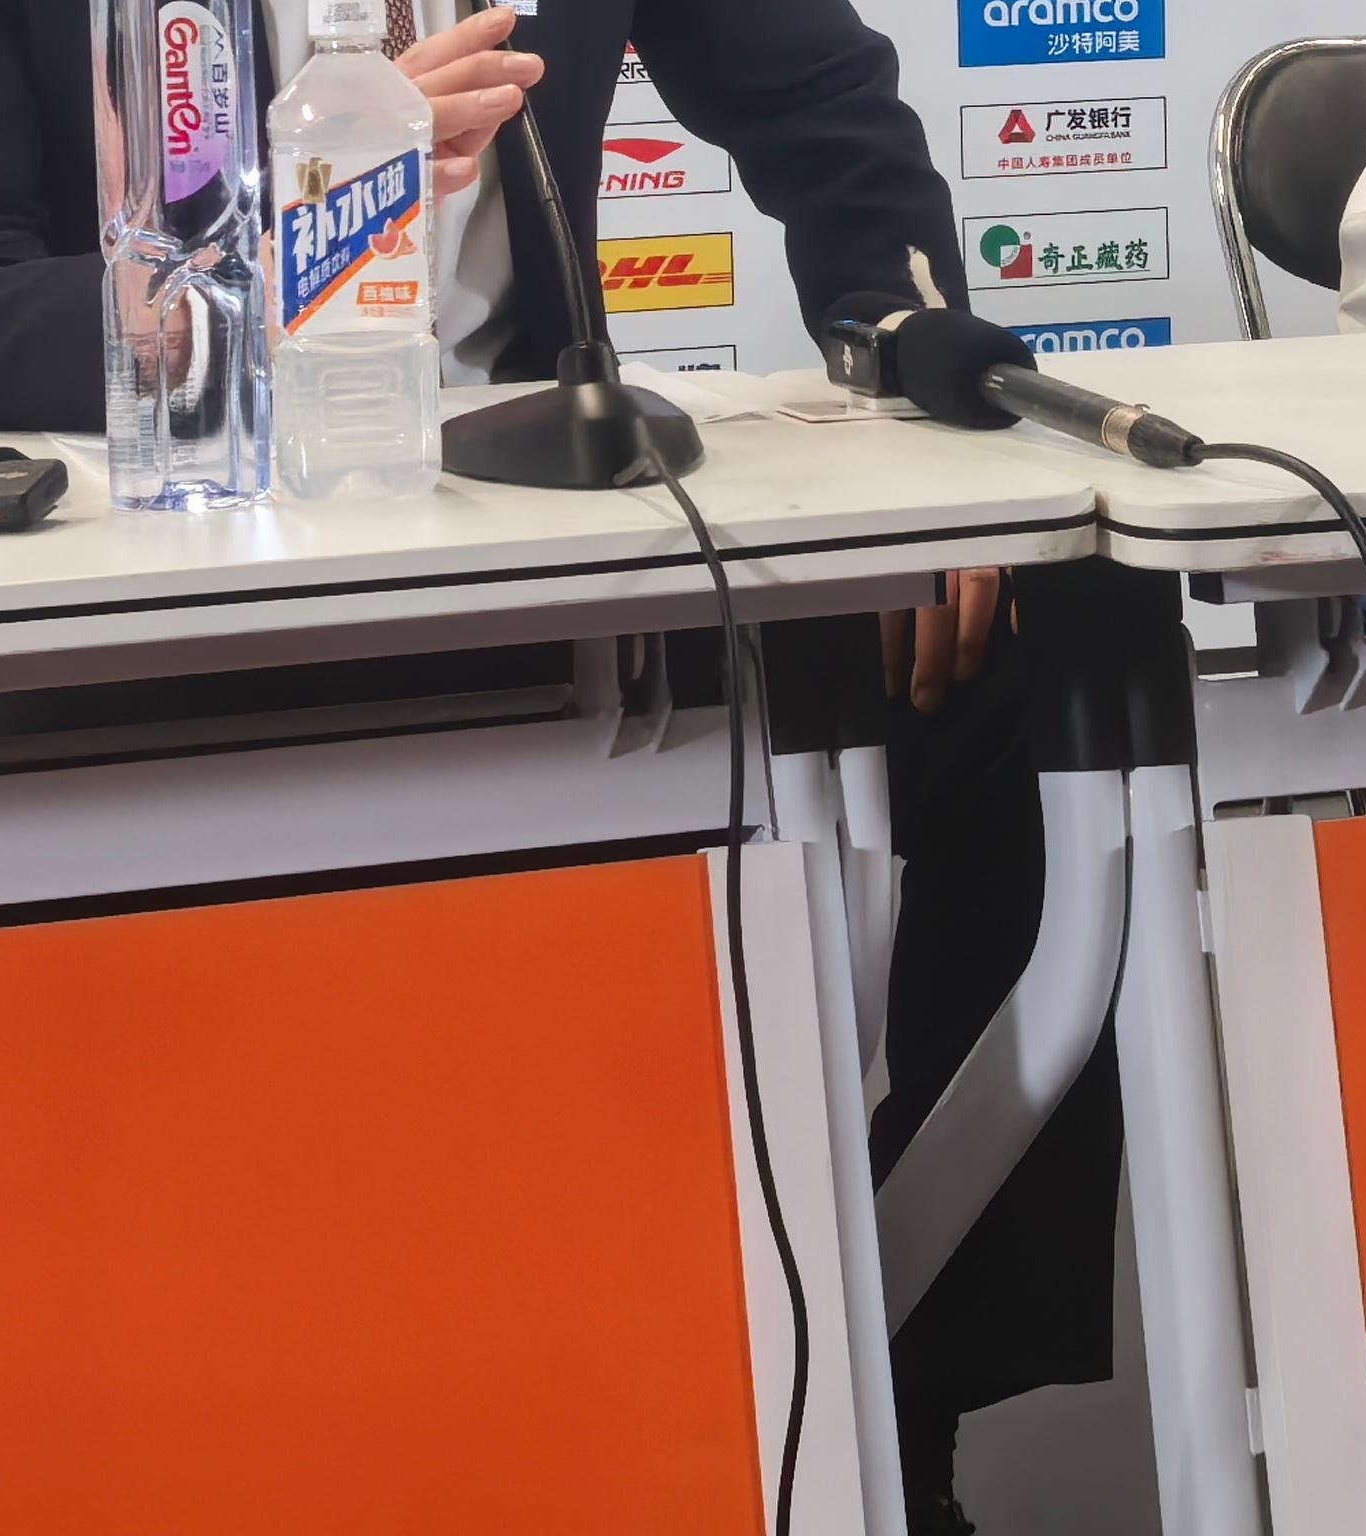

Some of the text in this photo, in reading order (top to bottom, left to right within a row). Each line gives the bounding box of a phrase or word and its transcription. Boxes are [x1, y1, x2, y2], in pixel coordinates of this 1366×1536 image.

[1045, 29, 1140, 56] 沙特阿美
[211, 63, 229, 135] 百岁山
[1045, 105, 1131, 132] 广发银行
[292, 161, 406, 274] 补水啦
[598, 254, 703, 290] HL
[1037, 235, 1149, 275] 奇正藏药
